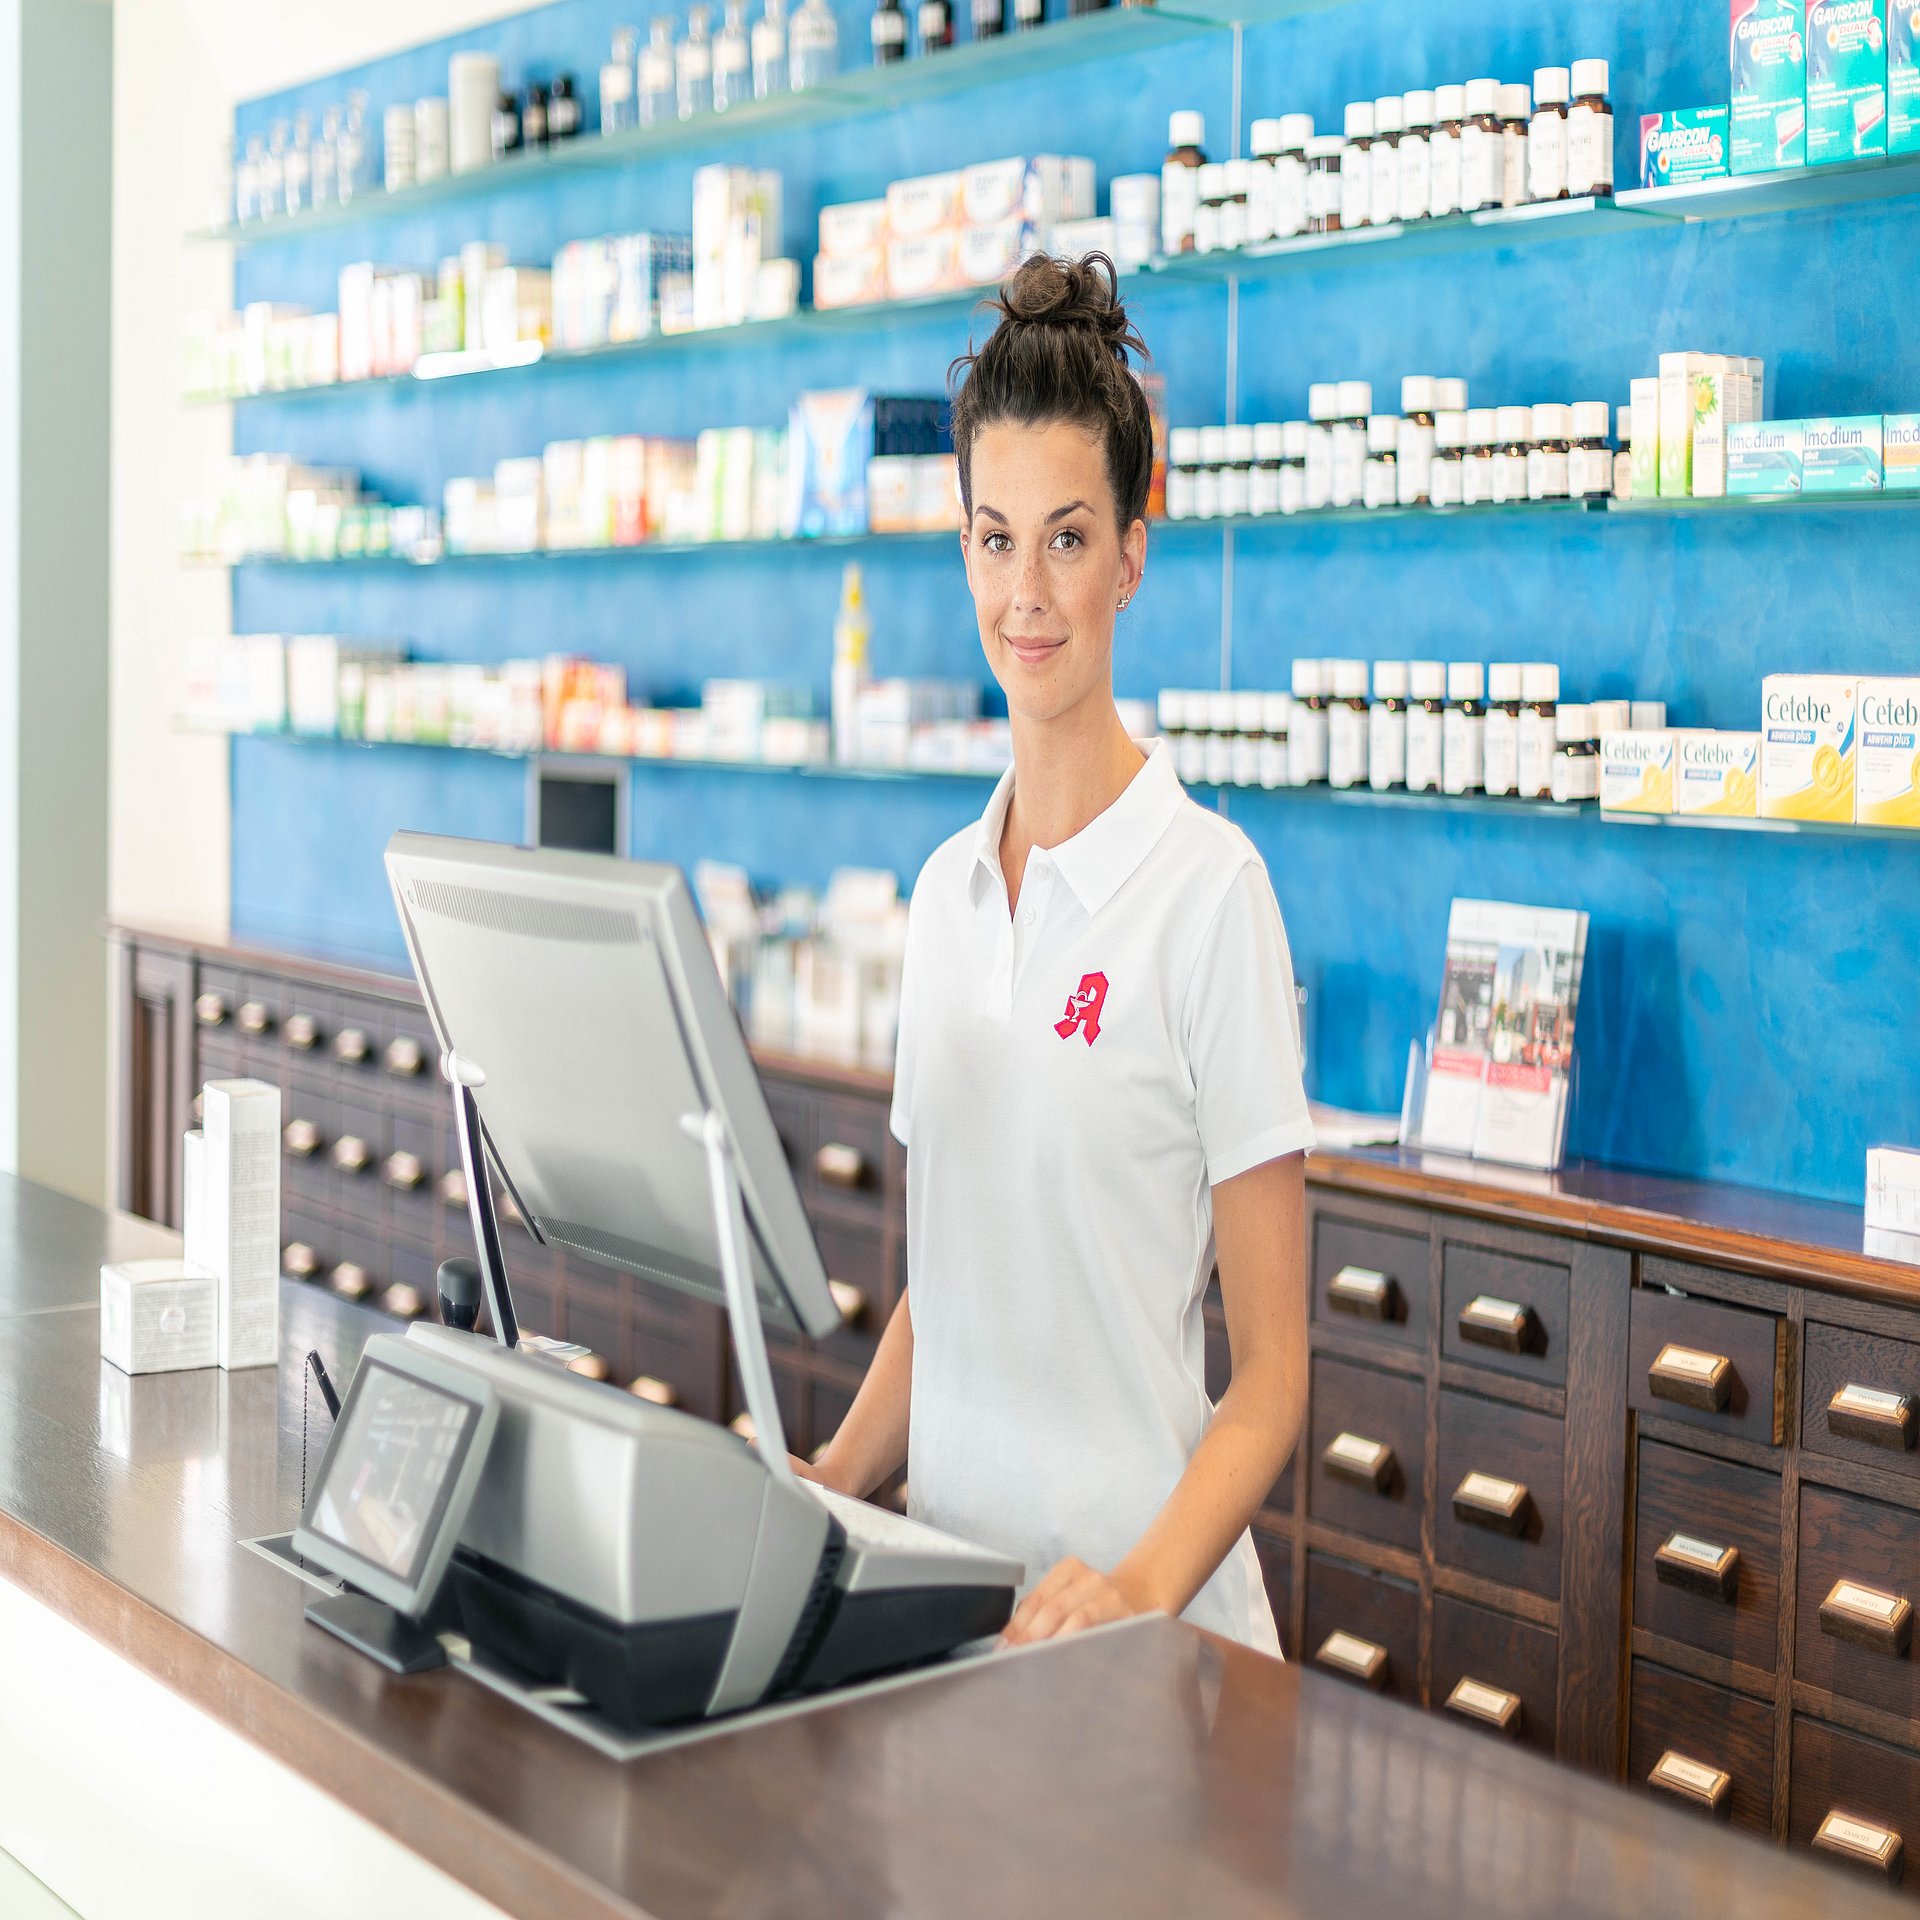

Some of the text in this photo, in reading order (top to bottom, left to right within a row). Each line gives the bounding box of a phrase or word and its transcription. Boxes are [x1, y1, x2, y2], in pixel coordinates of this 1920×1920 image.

[1813, 1, 1873, 26] GAVISCON
[1738, 15, 1794, 40] GAVISCON
[1839, 21, 1865, 34] DUAL
[1648, 126, 1710, 152] GAVISCON
[1729, 431, 1785, 449] Imodium
[1804, 426, 1862, 446] Imodium
[1767, 693, 1831, 723] Cetebe
[1863, 696, 1920, 726] Ceteb
[1604, 739, 1651, 761] Cetebe
[1866, 732, 1911, 748] ABWEHR plus
[1684, 741, 1734, 764] Cetebe
